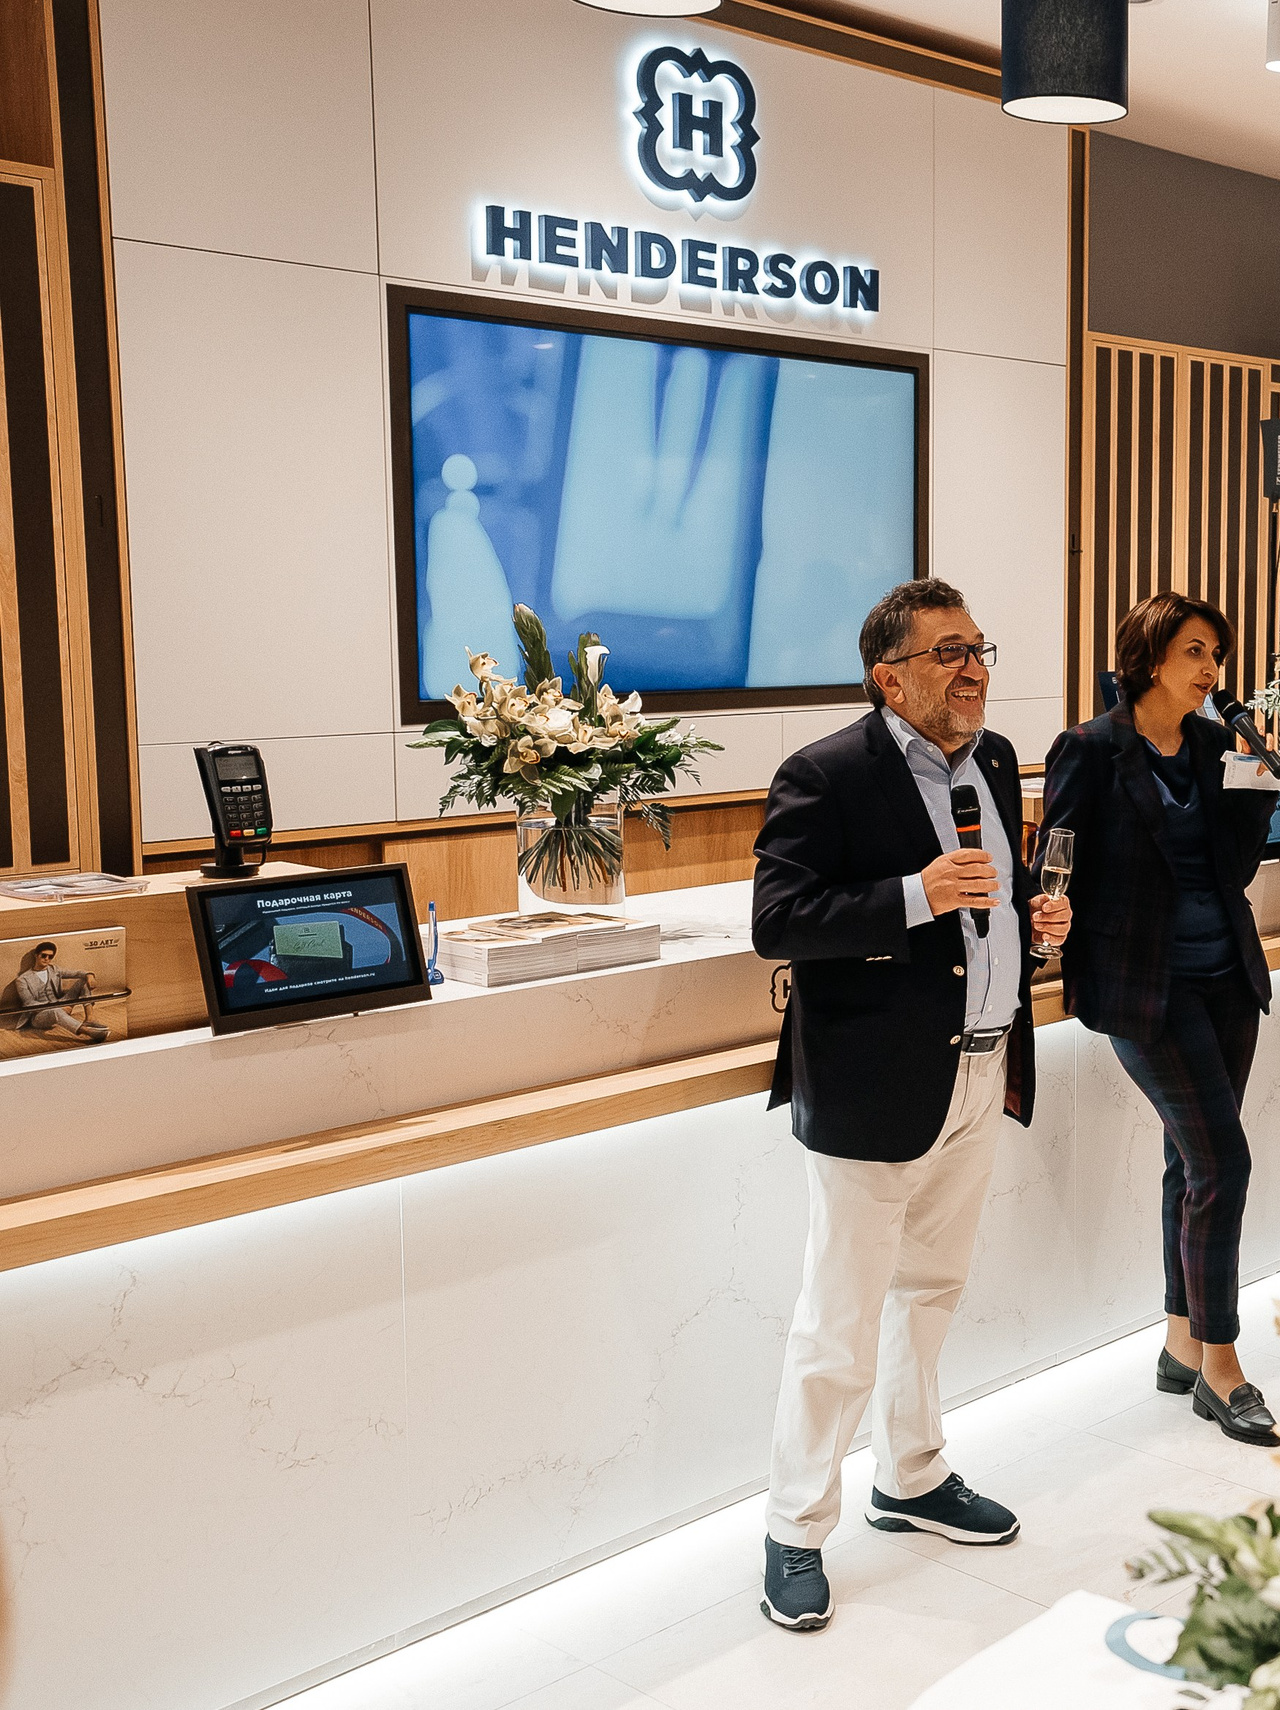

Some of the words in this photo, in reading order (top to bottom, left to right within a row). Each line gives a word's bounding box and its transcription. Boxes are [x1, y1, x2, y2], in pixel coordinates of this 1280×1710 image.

[671, 91, 724, 158] H
[484, 204, 880, 313] HENDERSON
[257, 894, 322, 909] Подарочная
[323, 890, 353, 901] карта
